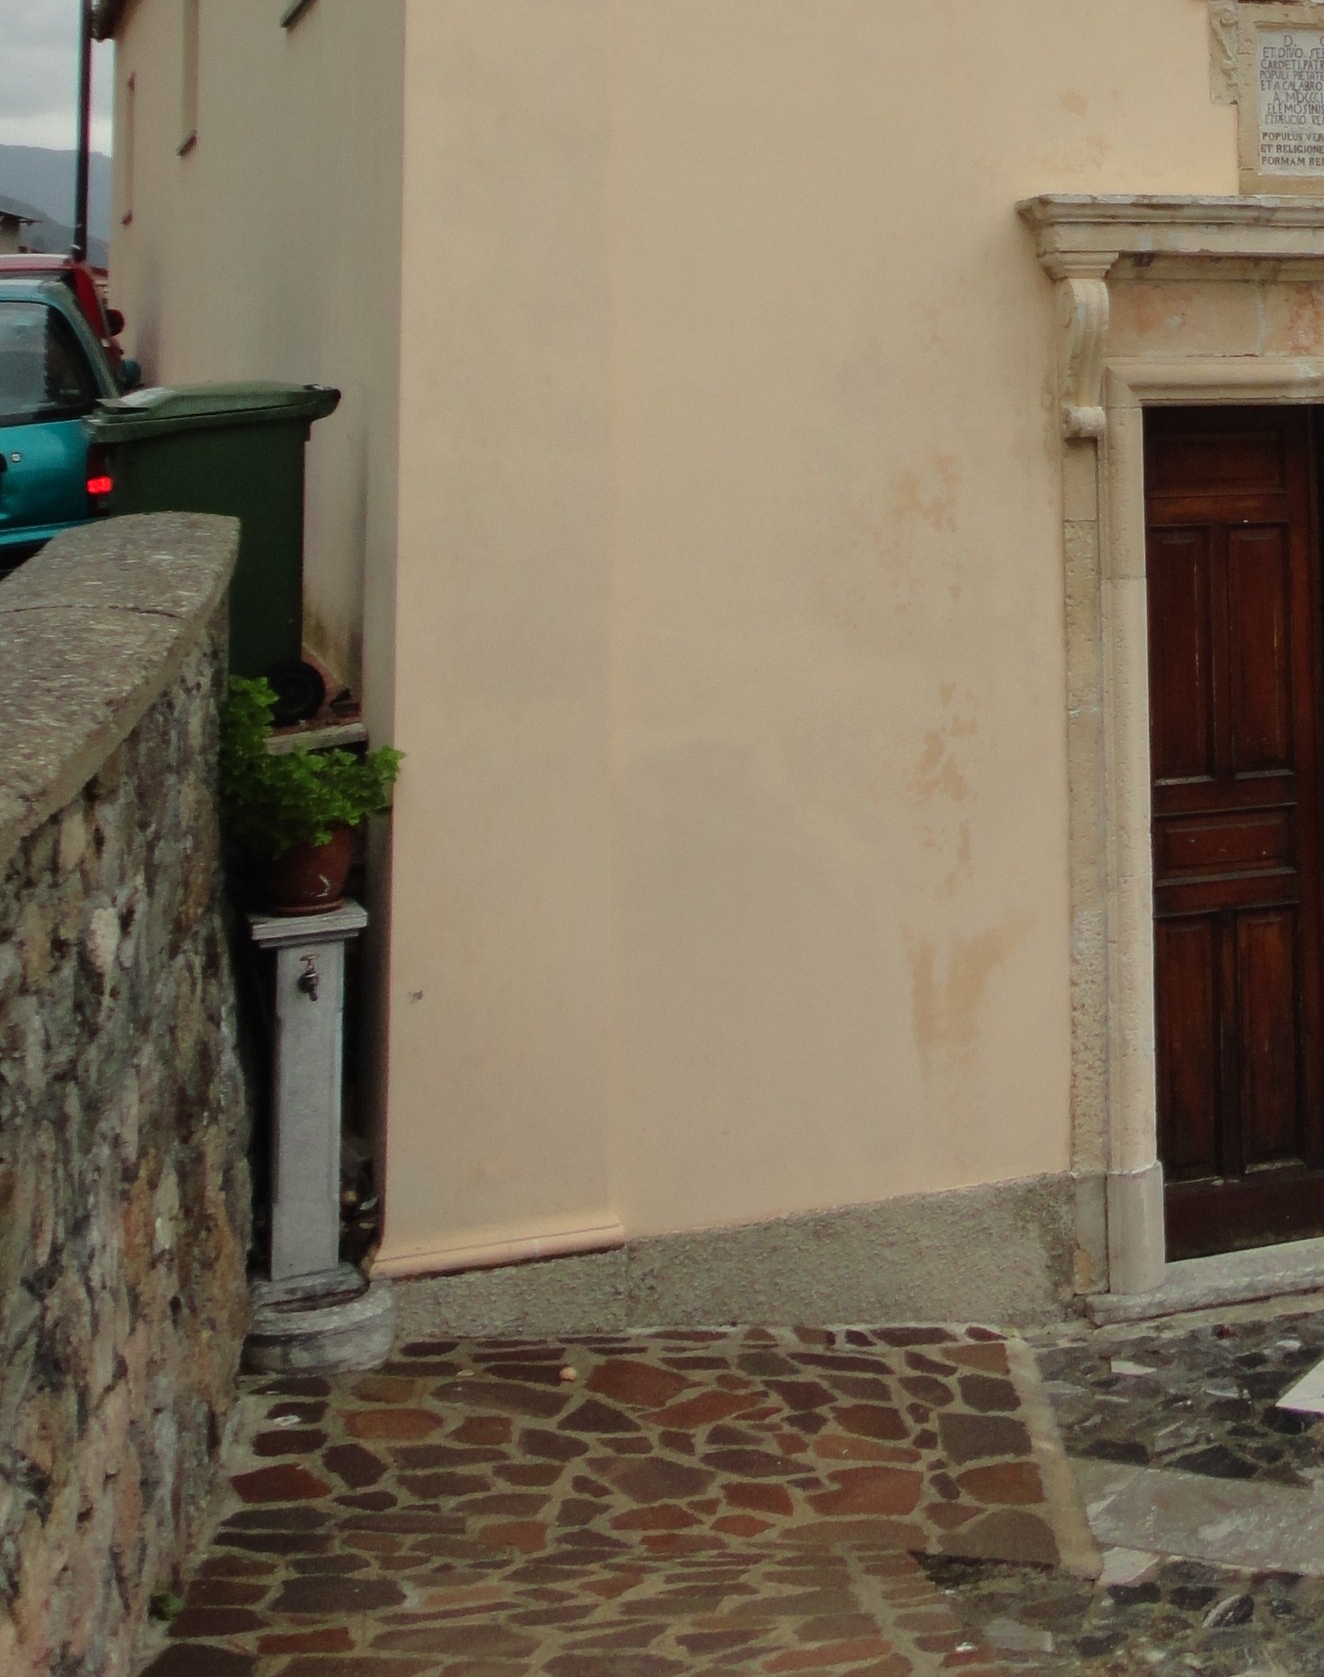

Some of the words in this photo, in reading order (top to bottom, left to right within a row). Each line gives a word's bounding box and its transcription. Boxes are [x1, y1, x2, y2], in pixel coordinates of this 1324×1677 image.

[1262, 132, 1303, 141] POPULUS
[1260, 144, 1273, 153] ET
[1261, 156, 1306, 166] FORMAM
